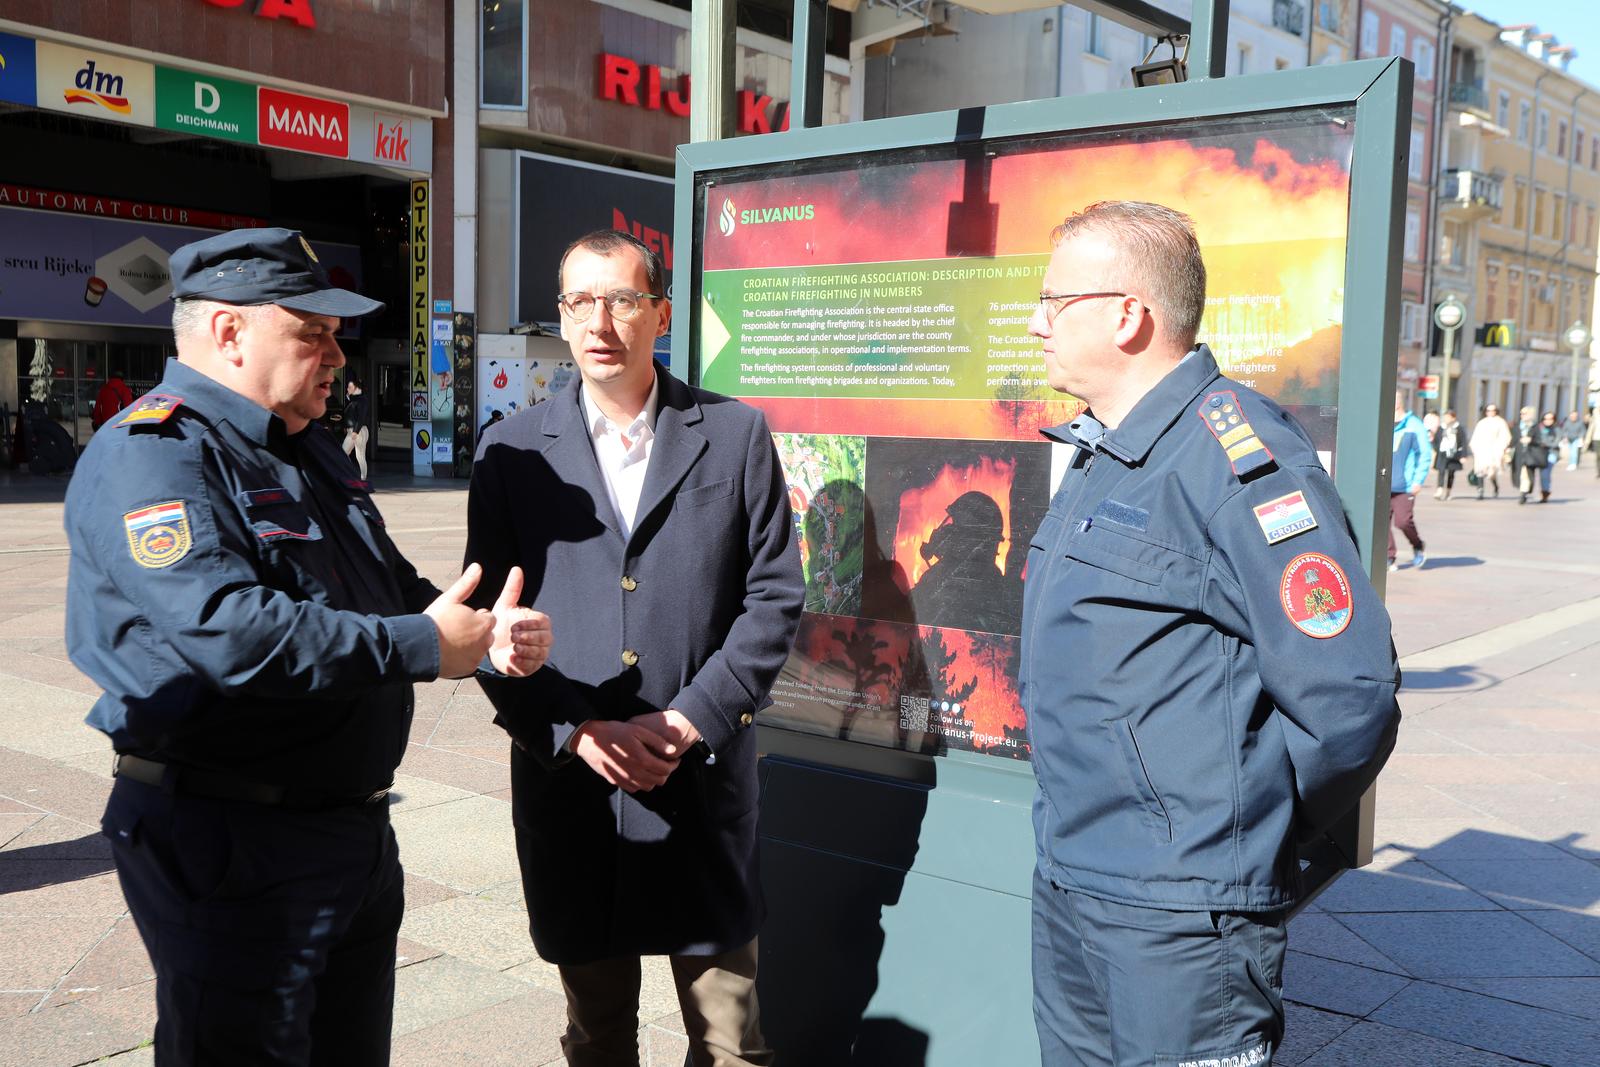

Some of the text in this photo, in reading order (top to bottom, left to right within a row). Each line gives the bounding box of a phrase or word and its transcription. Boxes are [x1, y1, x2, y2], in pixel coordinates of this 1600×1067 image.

[75, 60, 123, 96] dm
[194, 81, 220, 114] D
[600, 53, 790, 134] RIJK
[176, 113, 239, 133] DEICHMANN
[269, 104, 343, 142] MANA
[375, 120, 409, 162] kik
[0, 187, 189, 223] AUTOMAT CLUB
[740, 204, 815, 225] SILVANUS
[4, 256, 92, 277] srcu Rijeke
[743, 278, 789, 289] CROATIAN
[791, 274, 858, 287] FIREFIGHTING
[860, 271, 930, 284] ASSOCIATION:
[932, 268, 1003, 280] DESCRIPTION
[1006, 266, 1031, 278] AND
[413, 185, 427, 387] OTKUP ZLATA
[743, 286, 923, 302] CROATIAN FIREFIGHTING IN NUMBERS
[1229, 294, 1281, 309] firefighting
[742, 303, 955, 318] The Croatian Firefighting Association is the central state office
[988, 302, 999, 311] 76
[741, 316, 956, 331] responsible for managing firefighting. It is headed by the chief
[740, 331, 952, 343] fire commander, and under whose jurisdiction are the county
[987, 335, 1004, 345] The
[1004, 335, 1039, 345] Croatian
[740, 346, 777, 356] firefighting
[821, 345, 829, 354] in
[830, 345, 870, 355] operational
[871, 344, 885, 353] and
[886, 344, 946, 355] implementation
[947, 344, 972, 353] terms.
[987, 348, 1016, 358] Croatia
[1017, 349, 1033, 358] and
[740, 362, 950, 374] The firefighting system consists of professional and voluntary
[987, 363, 1047, 374] protection and
[1224, 361, 1277, 375] firefighters
[740, 375, 956, 387] firefighters from firefighting brigades and organizations. Today,
[986, 376, 1019, 387] perform
[1021, 378, 1032, 387] an
[1271, 520, 1313, 539] CROATIA
[930, 712, 953, 724] Follow
[954, 717, 963, 726] us
[929, 723, 1017, 748] Silvanus-Project.eu
